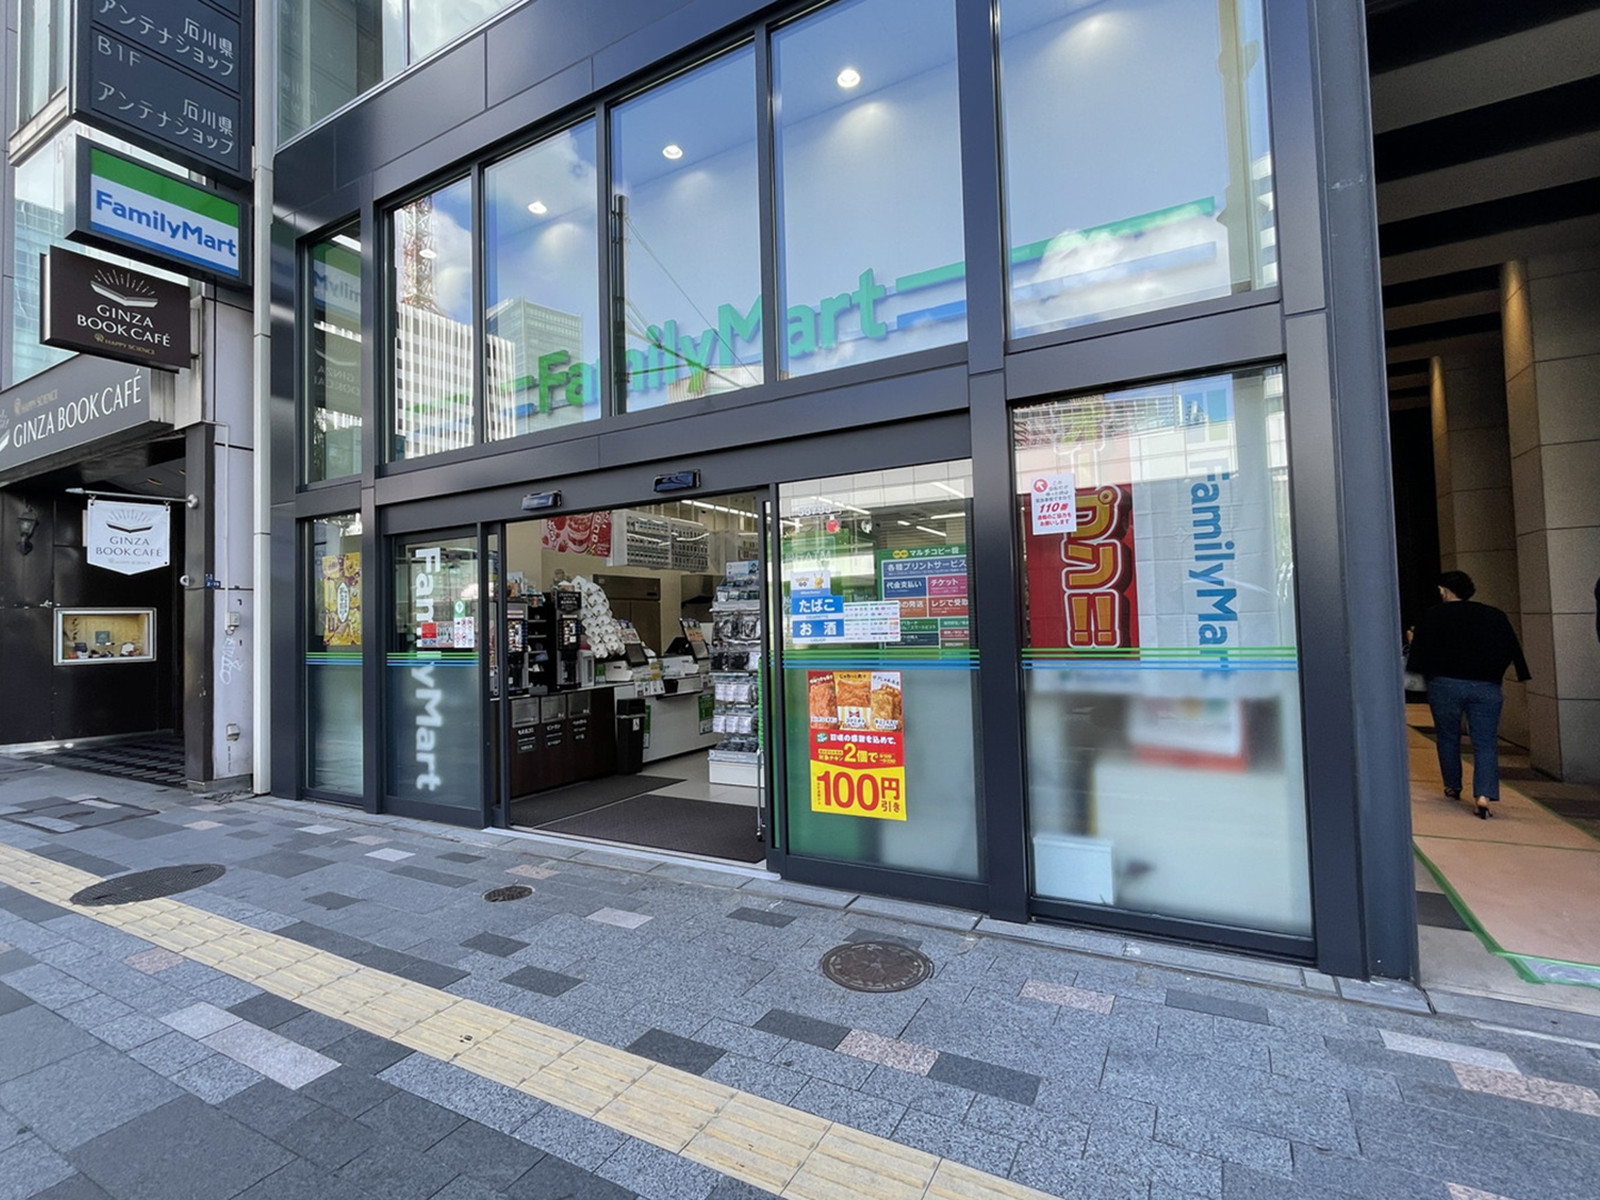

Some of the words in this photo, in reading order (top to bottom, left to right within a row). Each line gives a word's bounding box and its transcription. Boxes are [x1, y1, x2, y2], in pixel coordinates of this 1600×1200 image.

[184, 17, 233, 59] 石川県
[98, 35, 141, 67] B1F
[98, 81, 233, 154] アンテナショップ
[183, 99, 233, 137] 石川県
[95, 190, 236, 257] FamilyMart
[96, 304, 154, 328] GINZA
[77, 314, 128, 337] BOOK
[130, 328, 171, 348] CAFÉ
[105, 339, 127, 348] HAPPY
[13, 411, 55, 448] GINZA
[58, 392, 100, 432] BOOK
[101, 368, 142, 415] CAFÉ
[1039, 502, 1069, 514] 110番
[109, 536, 150, 546] GINZA
[96, 547, 132, 556] BOOK
[133, 547, 162, 557] CAFÉ
[887, 560, 967, 572] 各種プリントサービス
[886, 580, 922, 589] 代金支払い
[930, 578, 959, 587] チケット
[799, 598, 835, 613] たばこ
[817, 770, 900, 812] 100円
[881, 800, 900, 813] 引き
